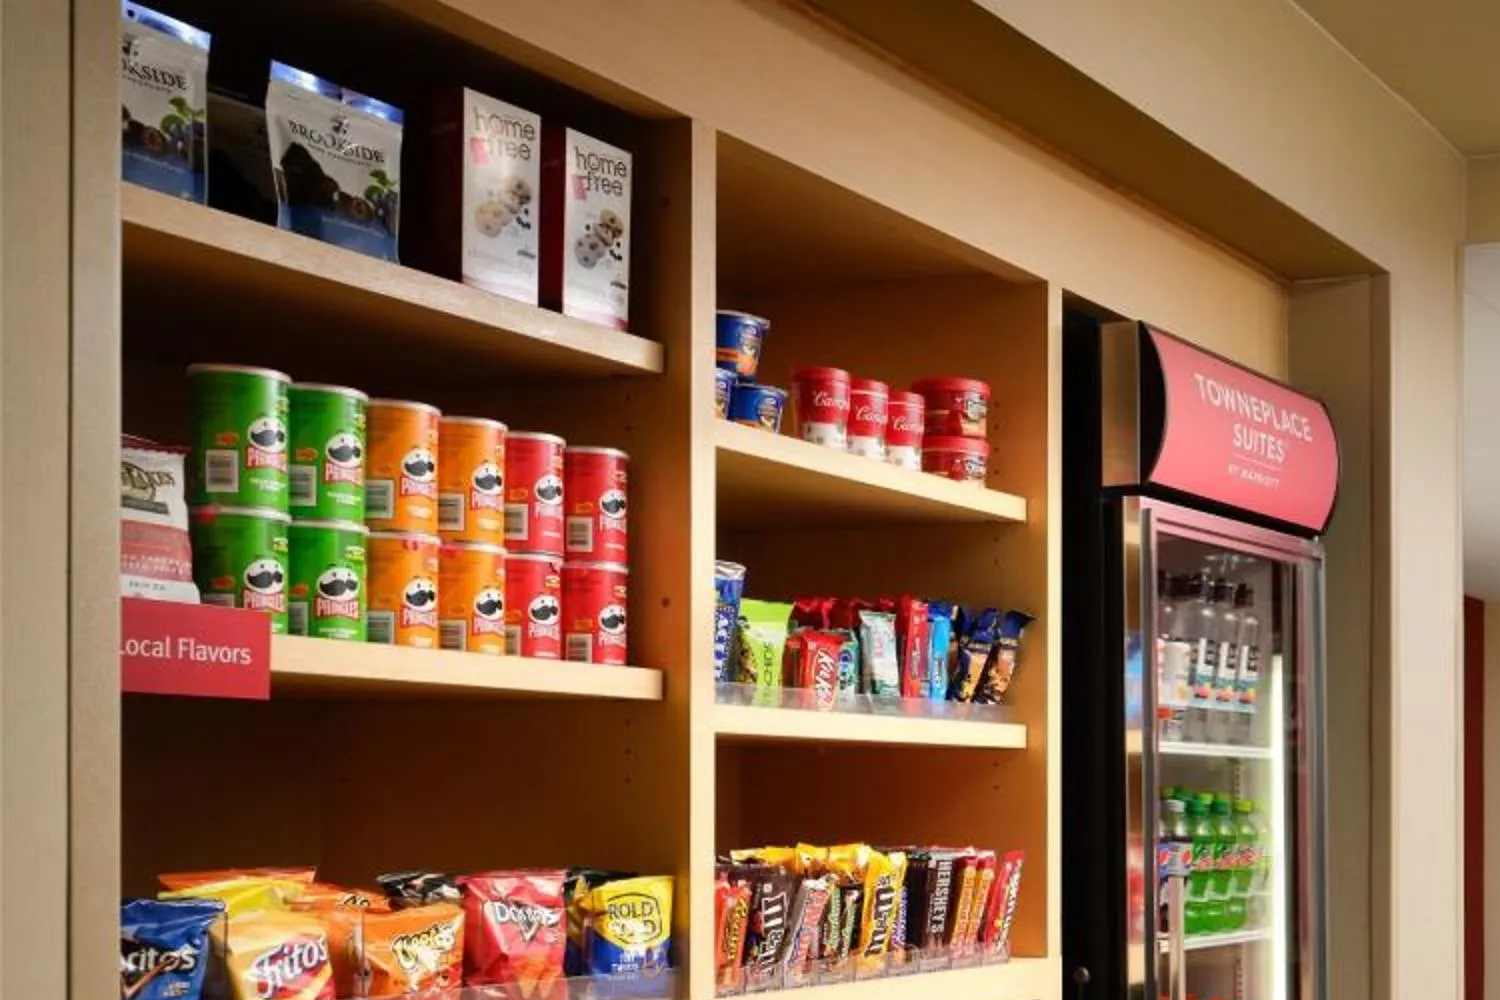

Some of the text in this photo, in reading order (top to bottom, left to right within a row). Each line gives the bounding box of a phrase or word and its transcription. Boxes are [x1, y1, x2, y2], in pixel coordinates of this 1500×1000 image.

[474, 107, 535, 141] home
[575, 146, 627, 178] home
[585, 170, 623, 196] free
[1193, 373, 1313, 442] TOWNEPLACE
[1233, 423, 1285, 463] SUITES
[118, 636, 252, 665] ocal Flavors
[608, 901, 654, 921] ROLD
[931, 860, 953, 934] HERSHEY'S
[250, 938, 327, 1000] Fritos
